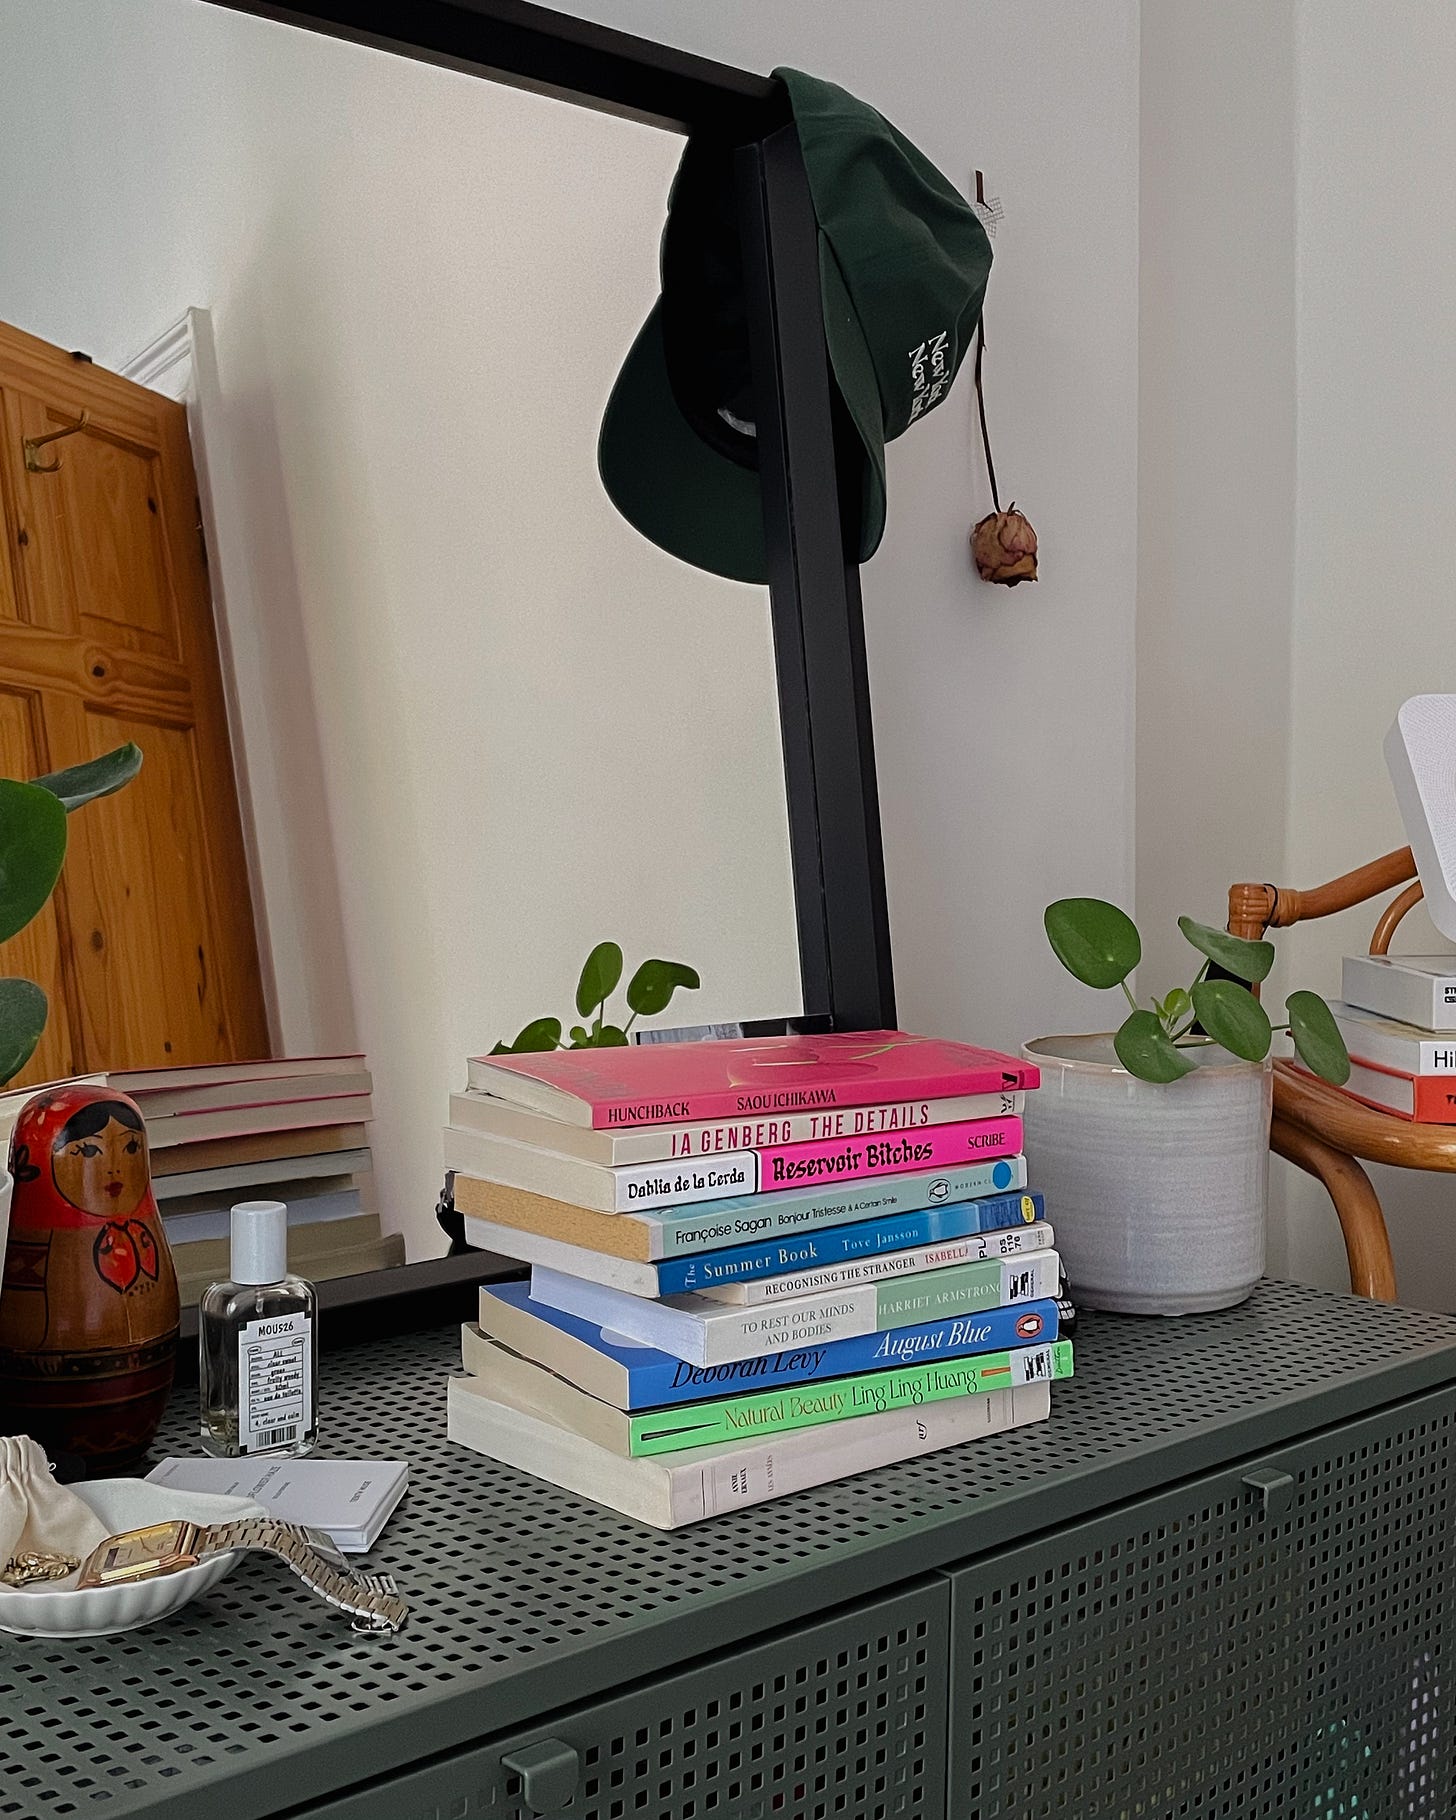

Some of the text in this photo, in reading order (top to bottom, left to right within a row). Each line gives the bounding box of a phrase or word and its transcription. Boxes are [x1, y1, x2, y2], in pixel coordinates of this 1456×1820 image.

[908, 342, 928, 392] New
[928, 330, 949, 376] New
[608, 1102, 690, 1122] HUNCHBACK
[672, 1104, 929, 1157] IA GENBERG THE DETAILS
[968, 1132, 1006, 1150] SCRIBE
[771, 1138, 933, 1181] Reservoir Bitches
[628, 1167, 745, 1200] Dahlia de la Cerda
[778, 1209, 811, 1226] Bonjour
[812, 1203, 846, 1219] Tristesse
[854, 1203, 859, 1211] A
[859, 1200, 882, 1210] Certain
[881, 1196, 898, 1205] Smile
[675, 1216, 772, 1245] Françoise Sagan
[841, 1228, 919, 1252] Tove Jansson
[684, 1263, 697, 1288] The
[703, 1241, 818, 1280] Summer Book
[765, 1256, 916, 1296] RECOGNISING THE STRANGER
[741, 1303, 855, 1334] TO REST OUR MINDS
[878, 1294, 930, 1316] HARRIET
[764, 1323, 832, 1346] AND BODIES
[873, 1319, 992, 1361] August Blue
[768, 1349, 827, 1376] Levy
[725, 1367, 977, 1430] Natural Beauty Ling Ling Huang
